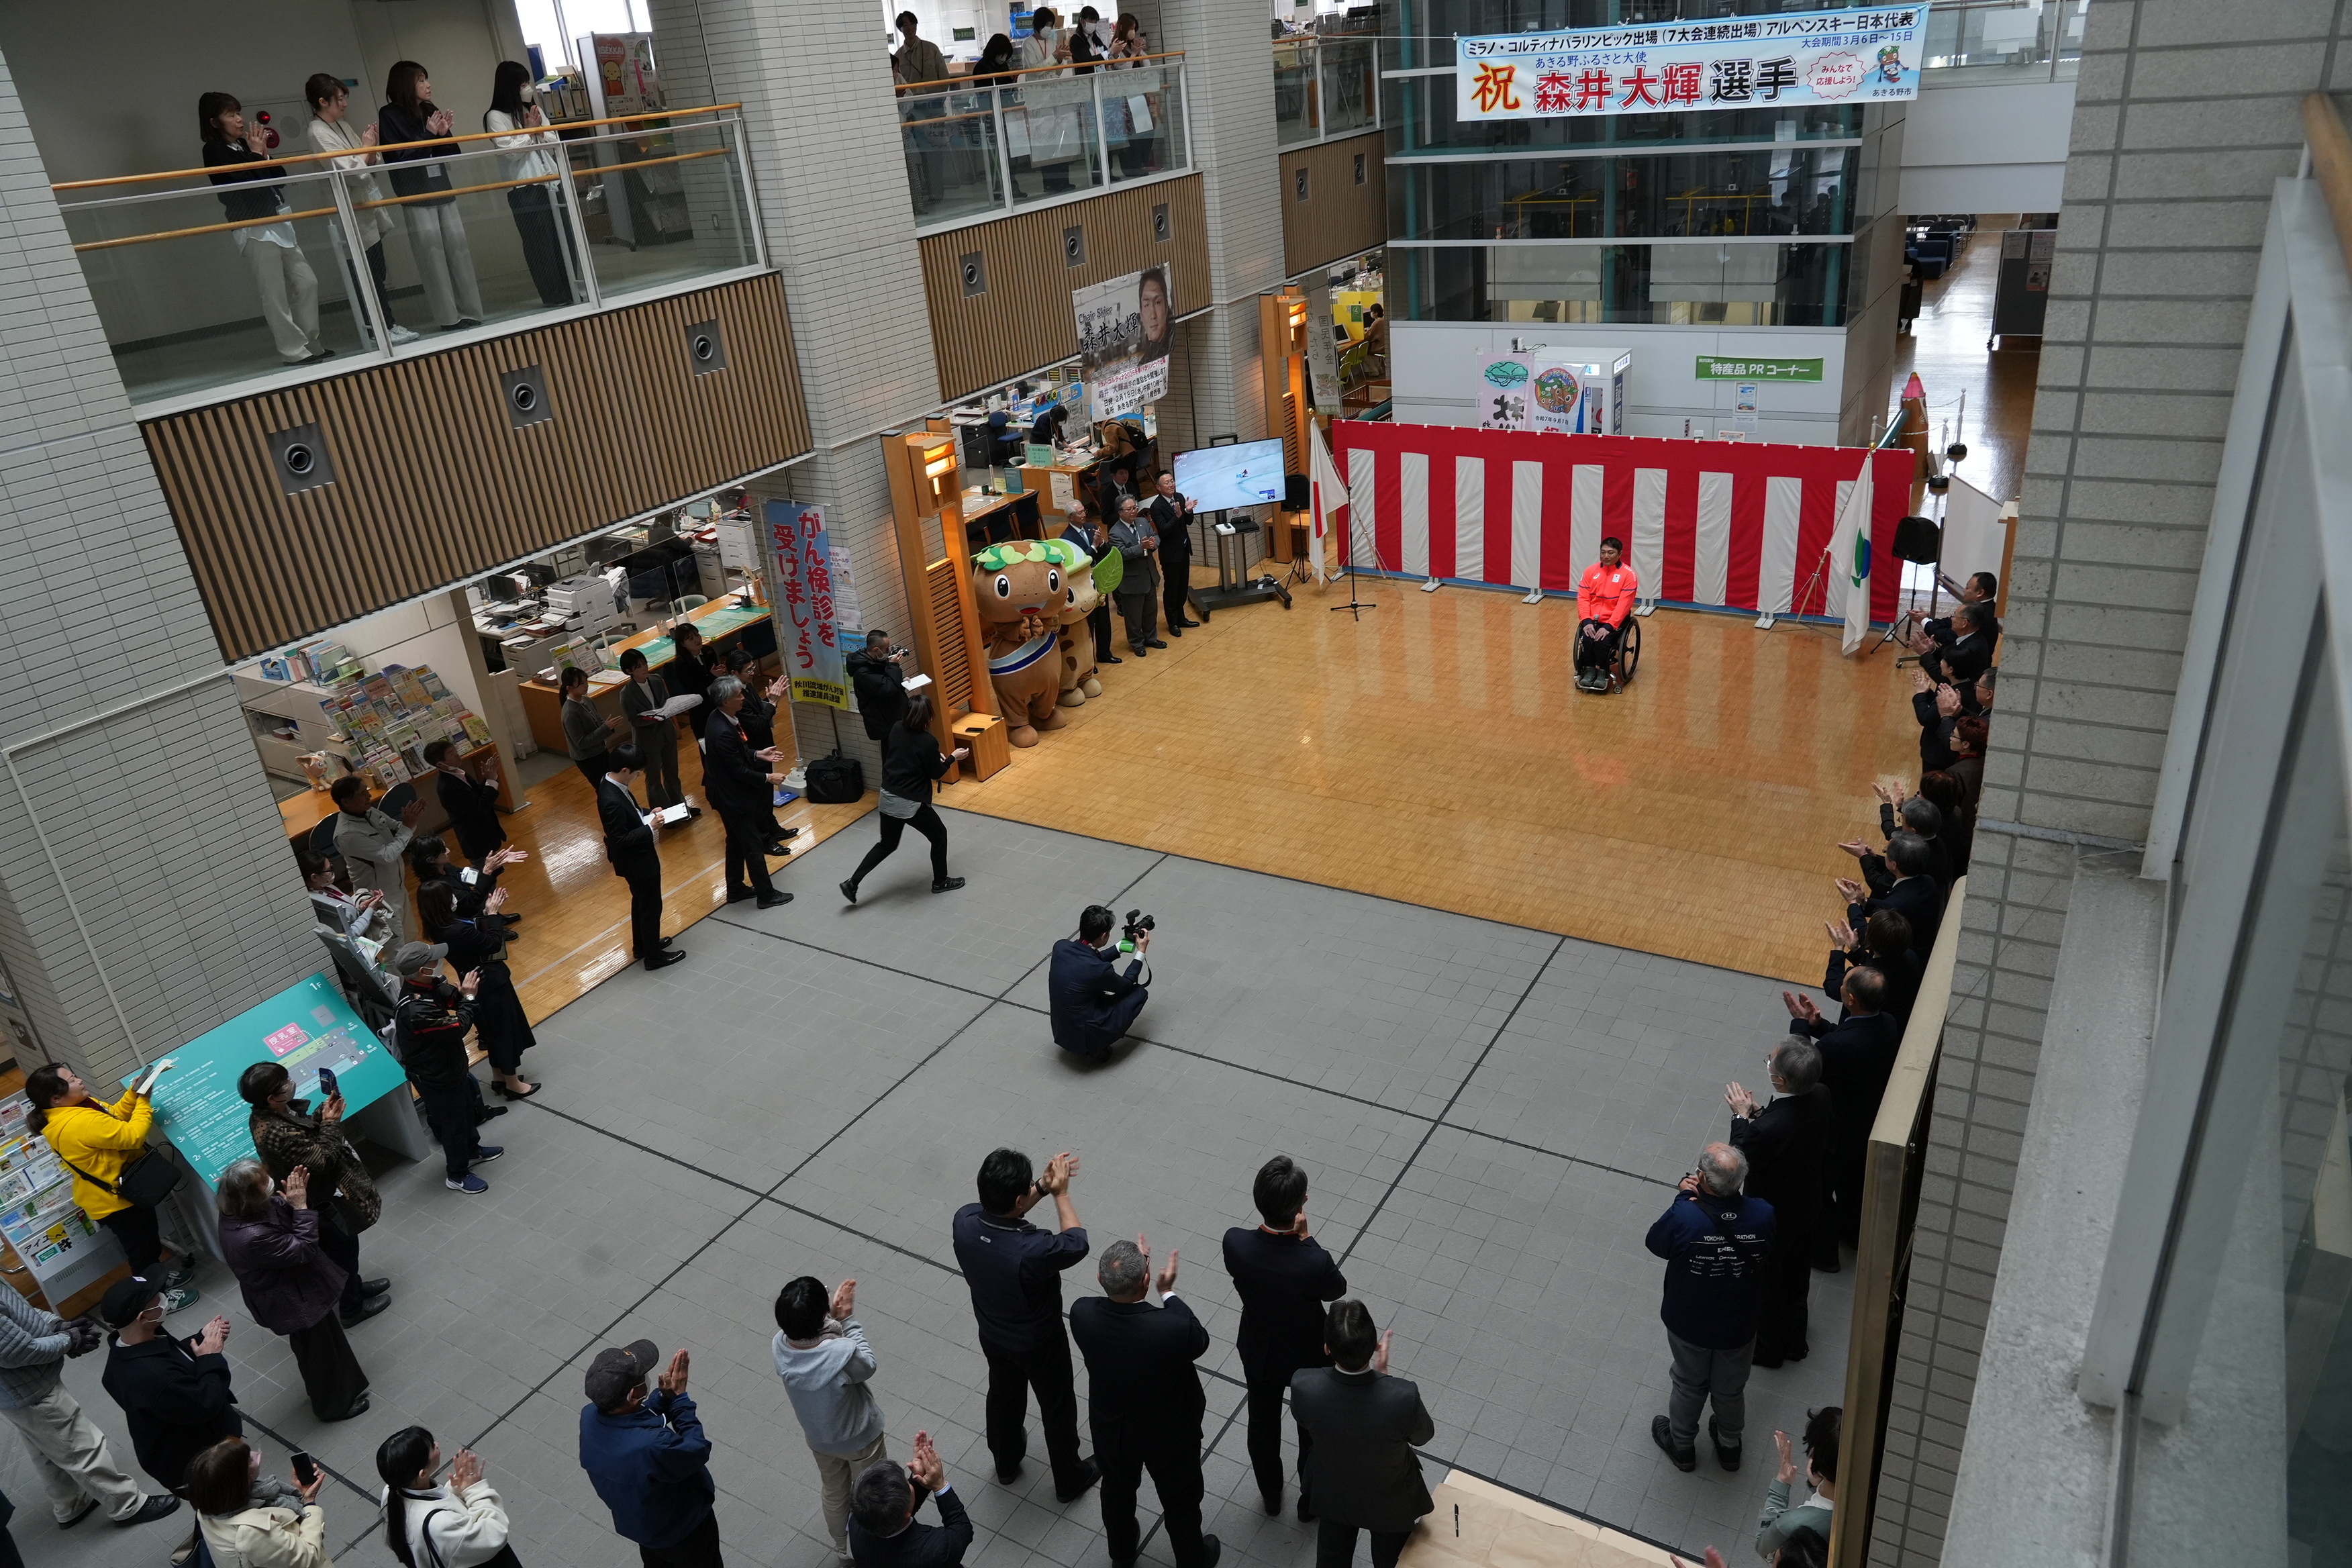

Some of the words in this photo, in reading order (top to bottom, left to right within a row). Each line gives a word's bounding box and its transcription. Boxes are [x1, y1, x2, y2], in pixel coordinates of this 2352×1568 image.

[1535, 51, 1647, 68] あきる野ふるさと大使
[1821, 63, 1853, 73] みんなで
[1471, 62, 1522, 113] 祝
[1872, 88, 1912, 97] あきる野市
[1078, 311, 1096, 325] Chair
[1096, 305, 1114, 320] Skier
[1749, 364, 1765, 375] PR
[1104, 397, 1113, 407] 日時
[1535, 415, 1569, 425] 令和7年9月1日
[798, 512, 835, 648] がん検診を
[773, 524, 814, 669] 受けましょう
[309, 982, 322, 990] 1F
[268, 1026, 297, 1045] 授乳室
